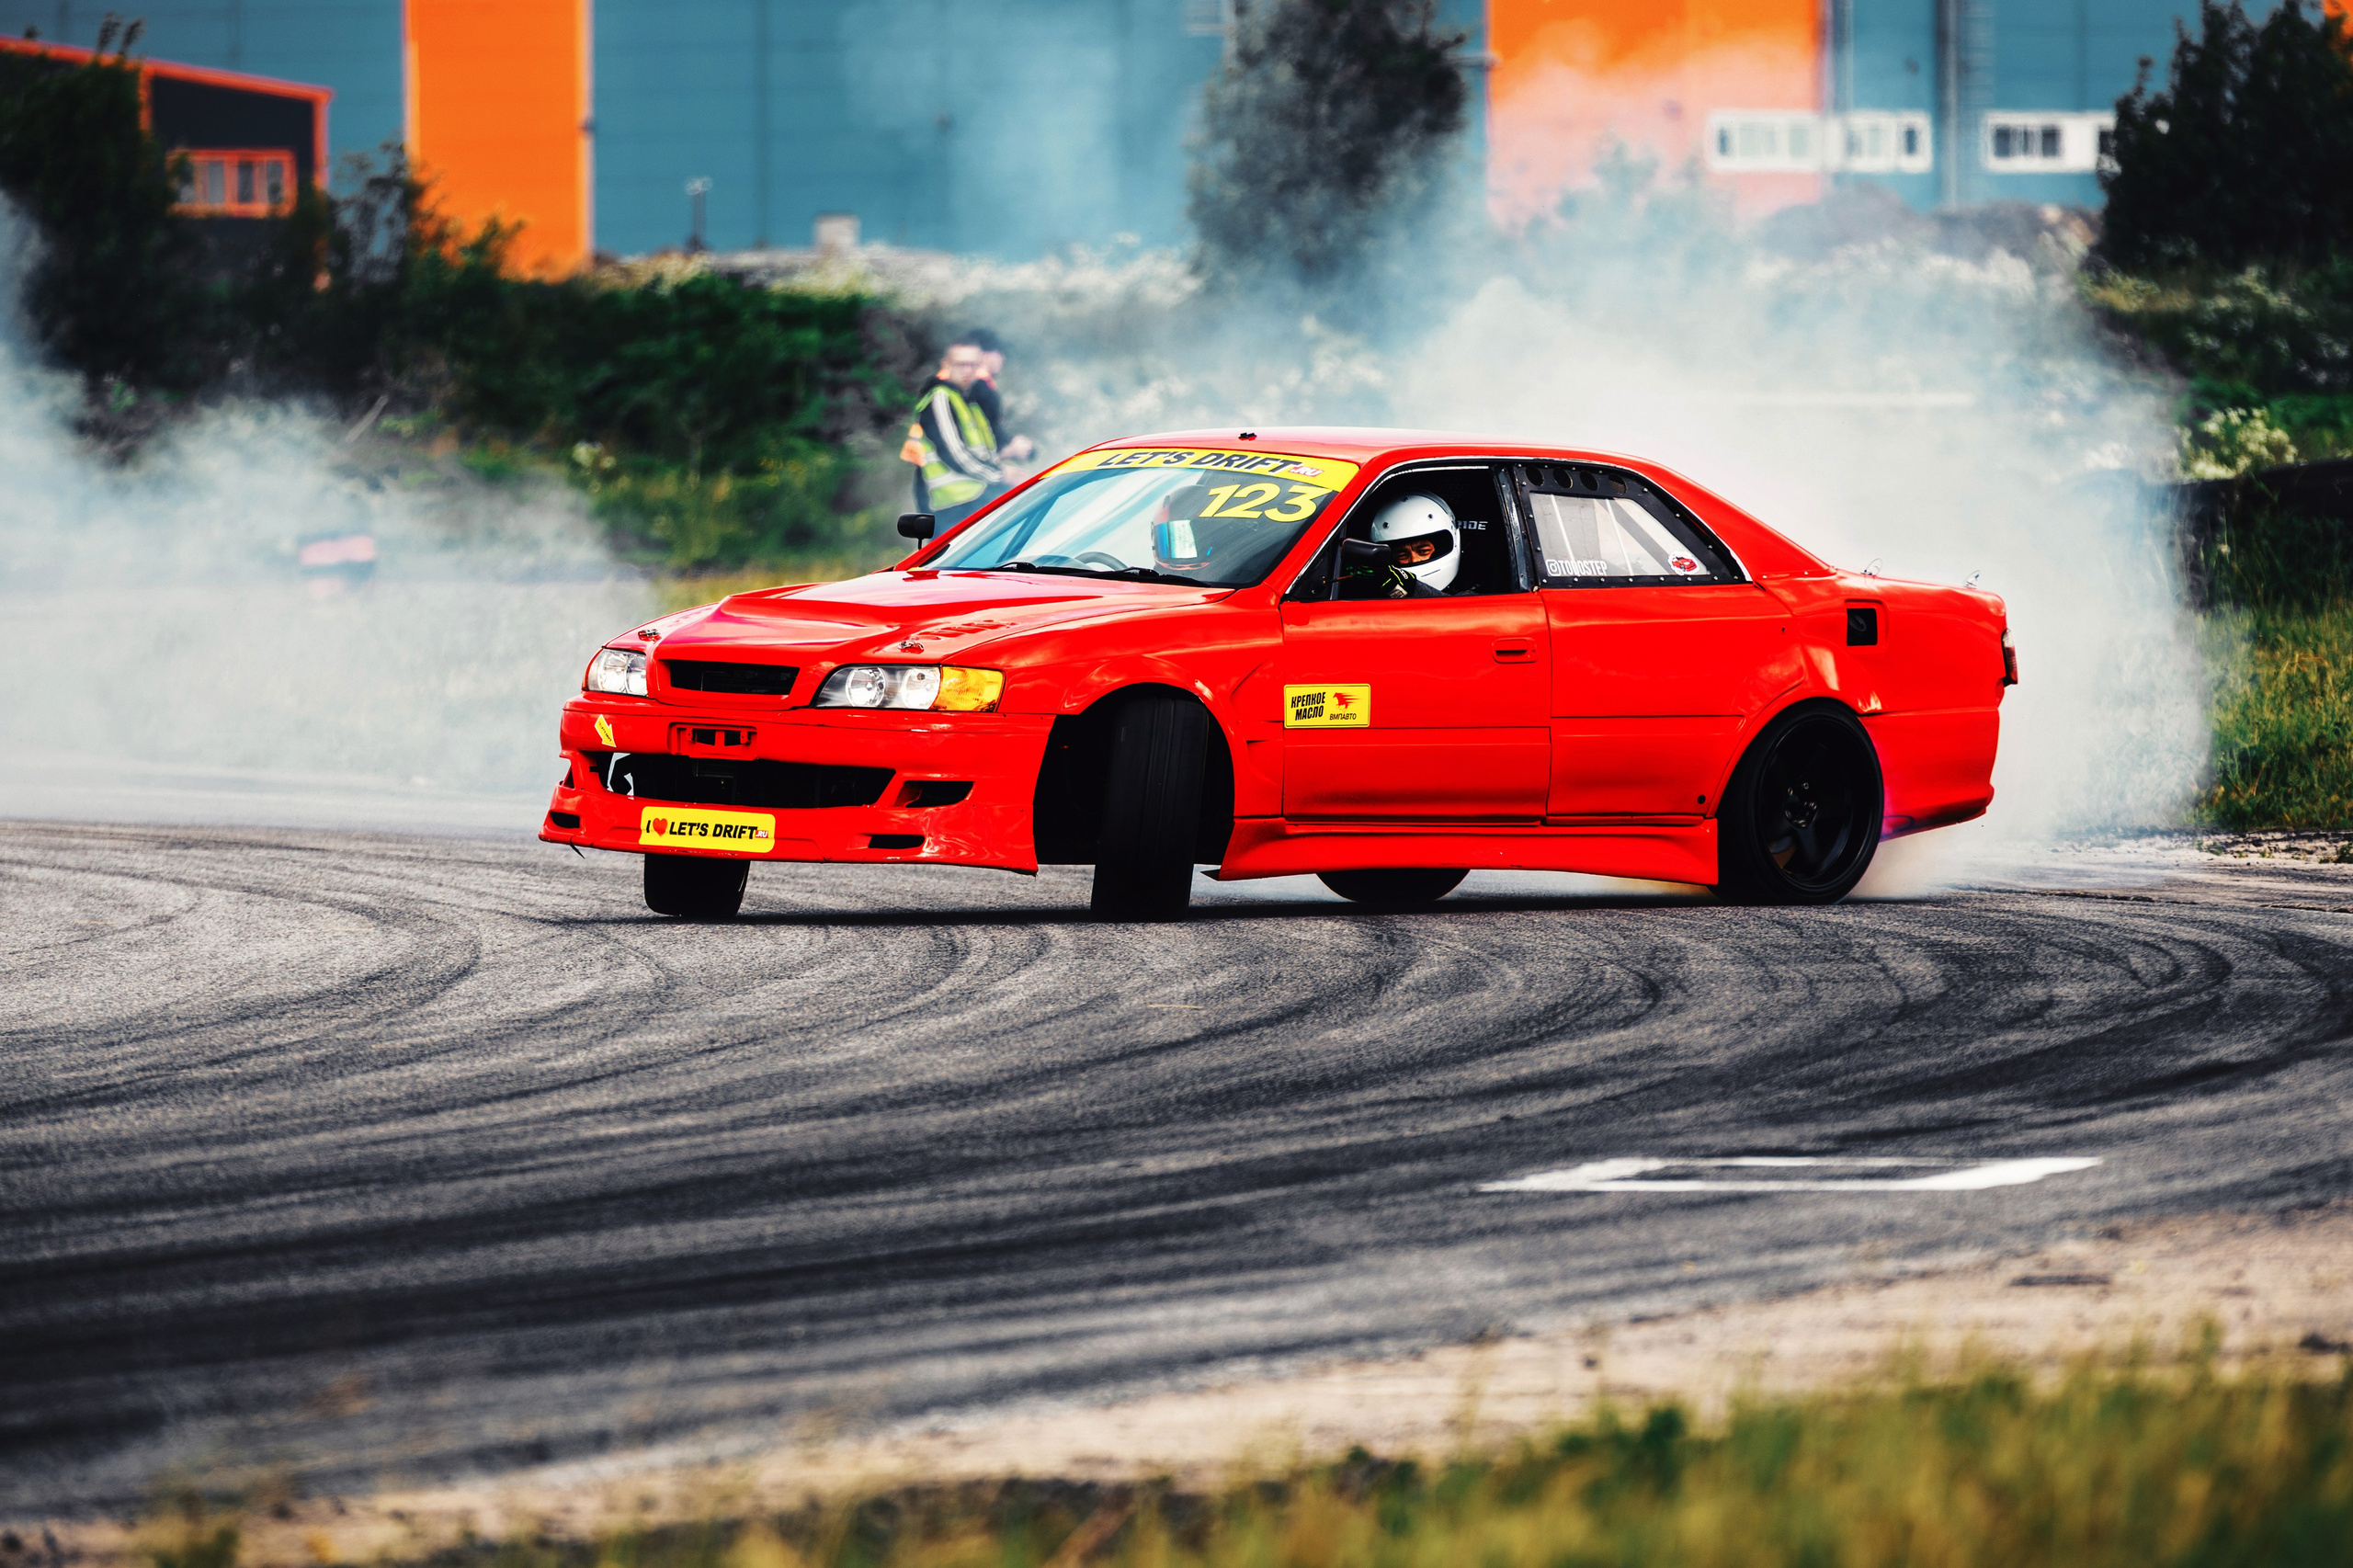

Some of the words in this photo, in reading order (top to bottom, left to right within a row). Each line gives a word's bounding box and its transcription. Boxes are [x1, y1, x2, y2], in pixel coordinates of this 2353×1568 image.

[1097, 451, 1194, 467] LET'S
[1199, 483, 1333, 522] 123
[1290, 692, 1325, 708] КРЕПКОЕ
[1295, 706, 1324, 721] МАСЛО
[646, 820, 651, 833] I
[669, 822, 709, 836] LET'S
